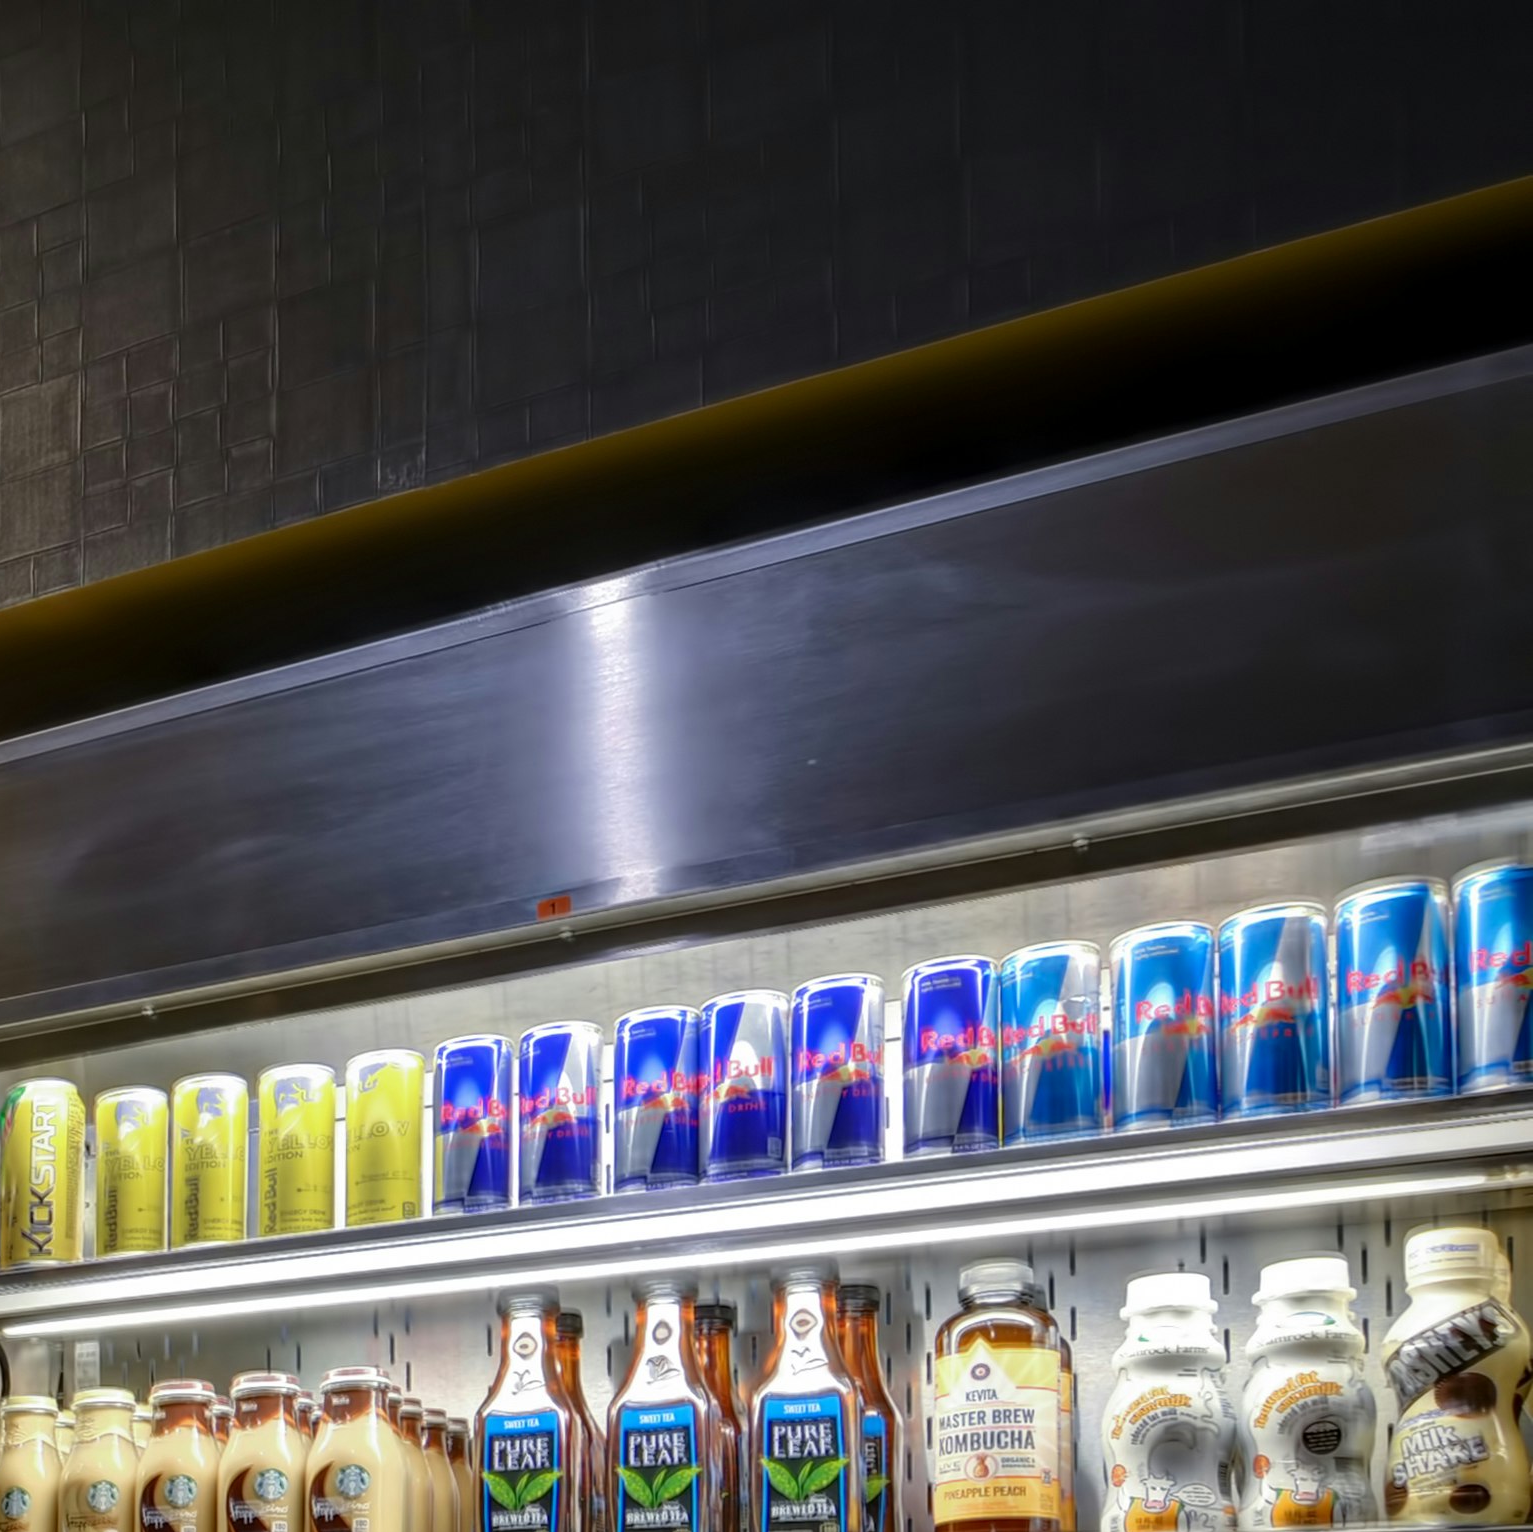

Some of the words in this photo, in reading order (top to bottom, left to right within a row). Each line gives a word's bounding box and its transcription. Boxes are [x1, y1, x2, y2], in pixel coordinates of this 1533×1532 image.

[1265, 976, 1319, 1003] Bull
[1346, 964, 1405, 993] Red
[1135, 989, 1192, 1020] Red
[1051, 1012, 1097, 1036] Bull
[921, 1024, 972, 1052] Red
[797, 1045, 847, 1071] Red
[553, 1086, 596, 1106] Bull
[622, 1071, 668, 1099] Red
[965, 1388, 999, 1402] KEVITA
[939, 1410, 987, 1431] MASTER
[991, 1408, 1035, 1425] BREW
[629, 1432, 685, 1452] PURE
[773, 1423, 832, 1444] PURE
[939, 1429, 1036, 1457] KOMBUCHA
[1401, 1425, 1462, 1458] Milk
[493, 1437, 550, 1456] PURE
[629, 1446, 687, 1467] LEAF
[773, 1437, 832, 1458] LEAF
[494, 1450, 550, 1471] LEAF
[1392, 1436, 1490, 1488] SHAKE
[944, 1487, 991, 1501] PINEAPPLE
[993, 1485, 1027, 1498] PEACH
